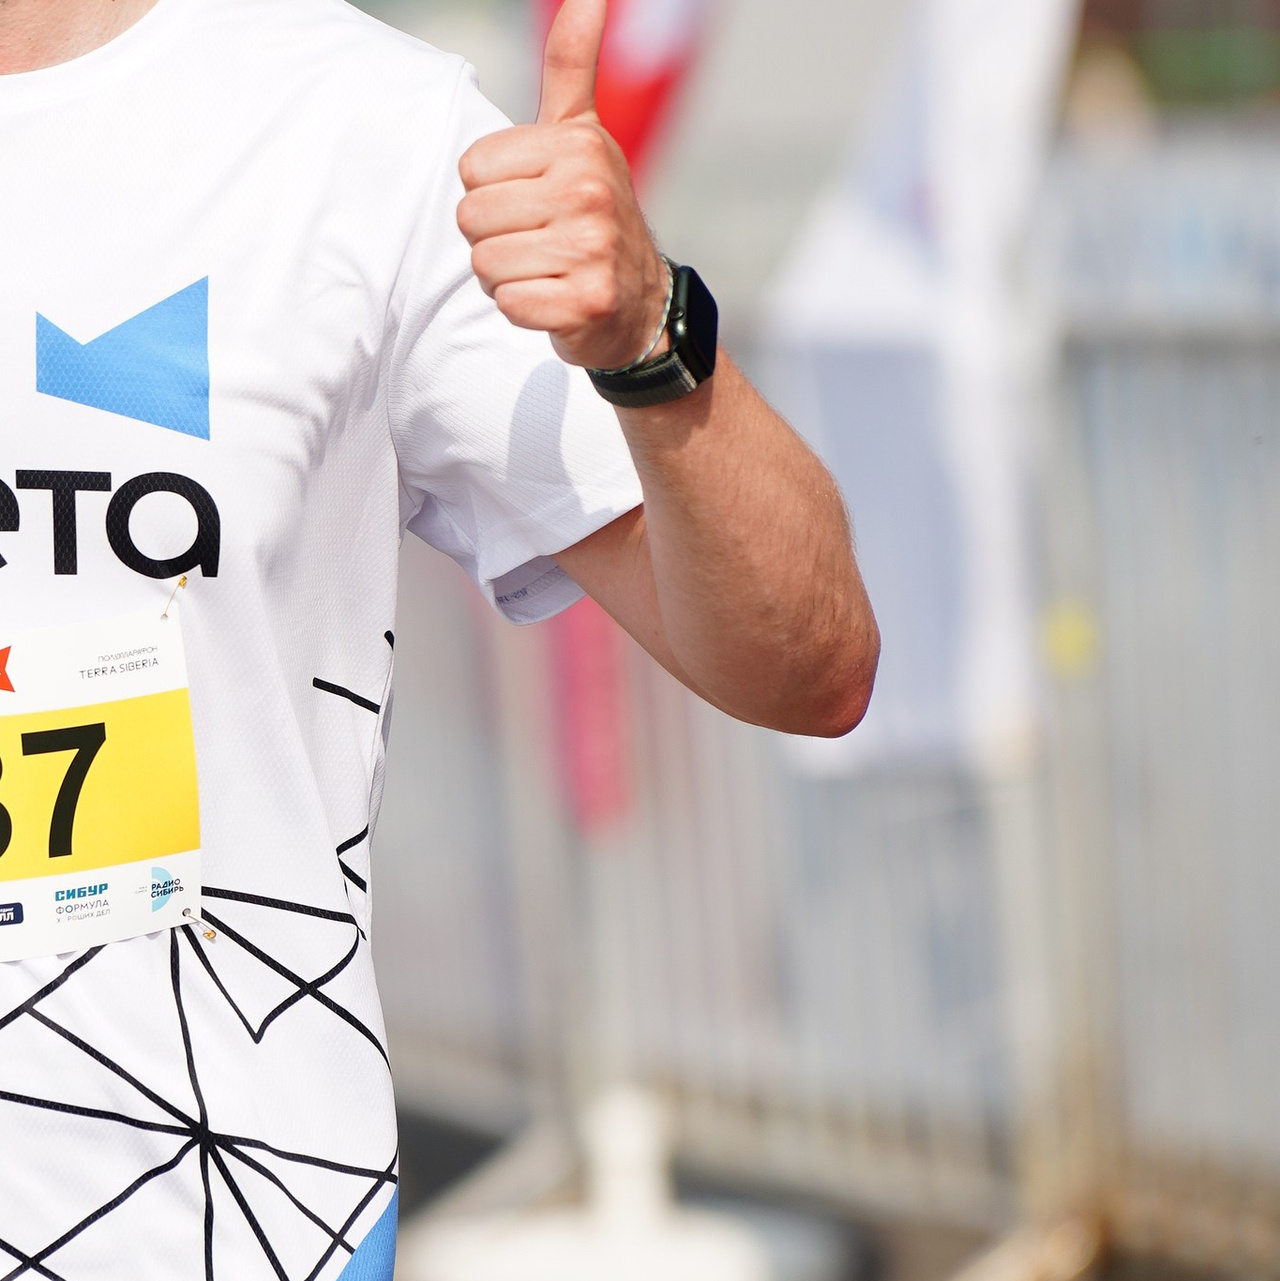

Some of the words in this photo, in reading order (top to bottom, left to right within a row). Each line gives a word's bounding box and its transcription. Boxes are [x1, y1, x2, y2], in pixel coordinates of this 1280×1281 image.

[79, 666, 117, 679] TERRA
[119, 658, 159, 673] SIBERIA
[151, 878, 181, 890] РАДИО
[55, 883, 108, 901] СИБУР
[151, 886, 184, 898] СИБИРЬ
[55, 899, 109, 914] ФОРМУЛА
[57, 911, 94, 923] ХРОШИХ
